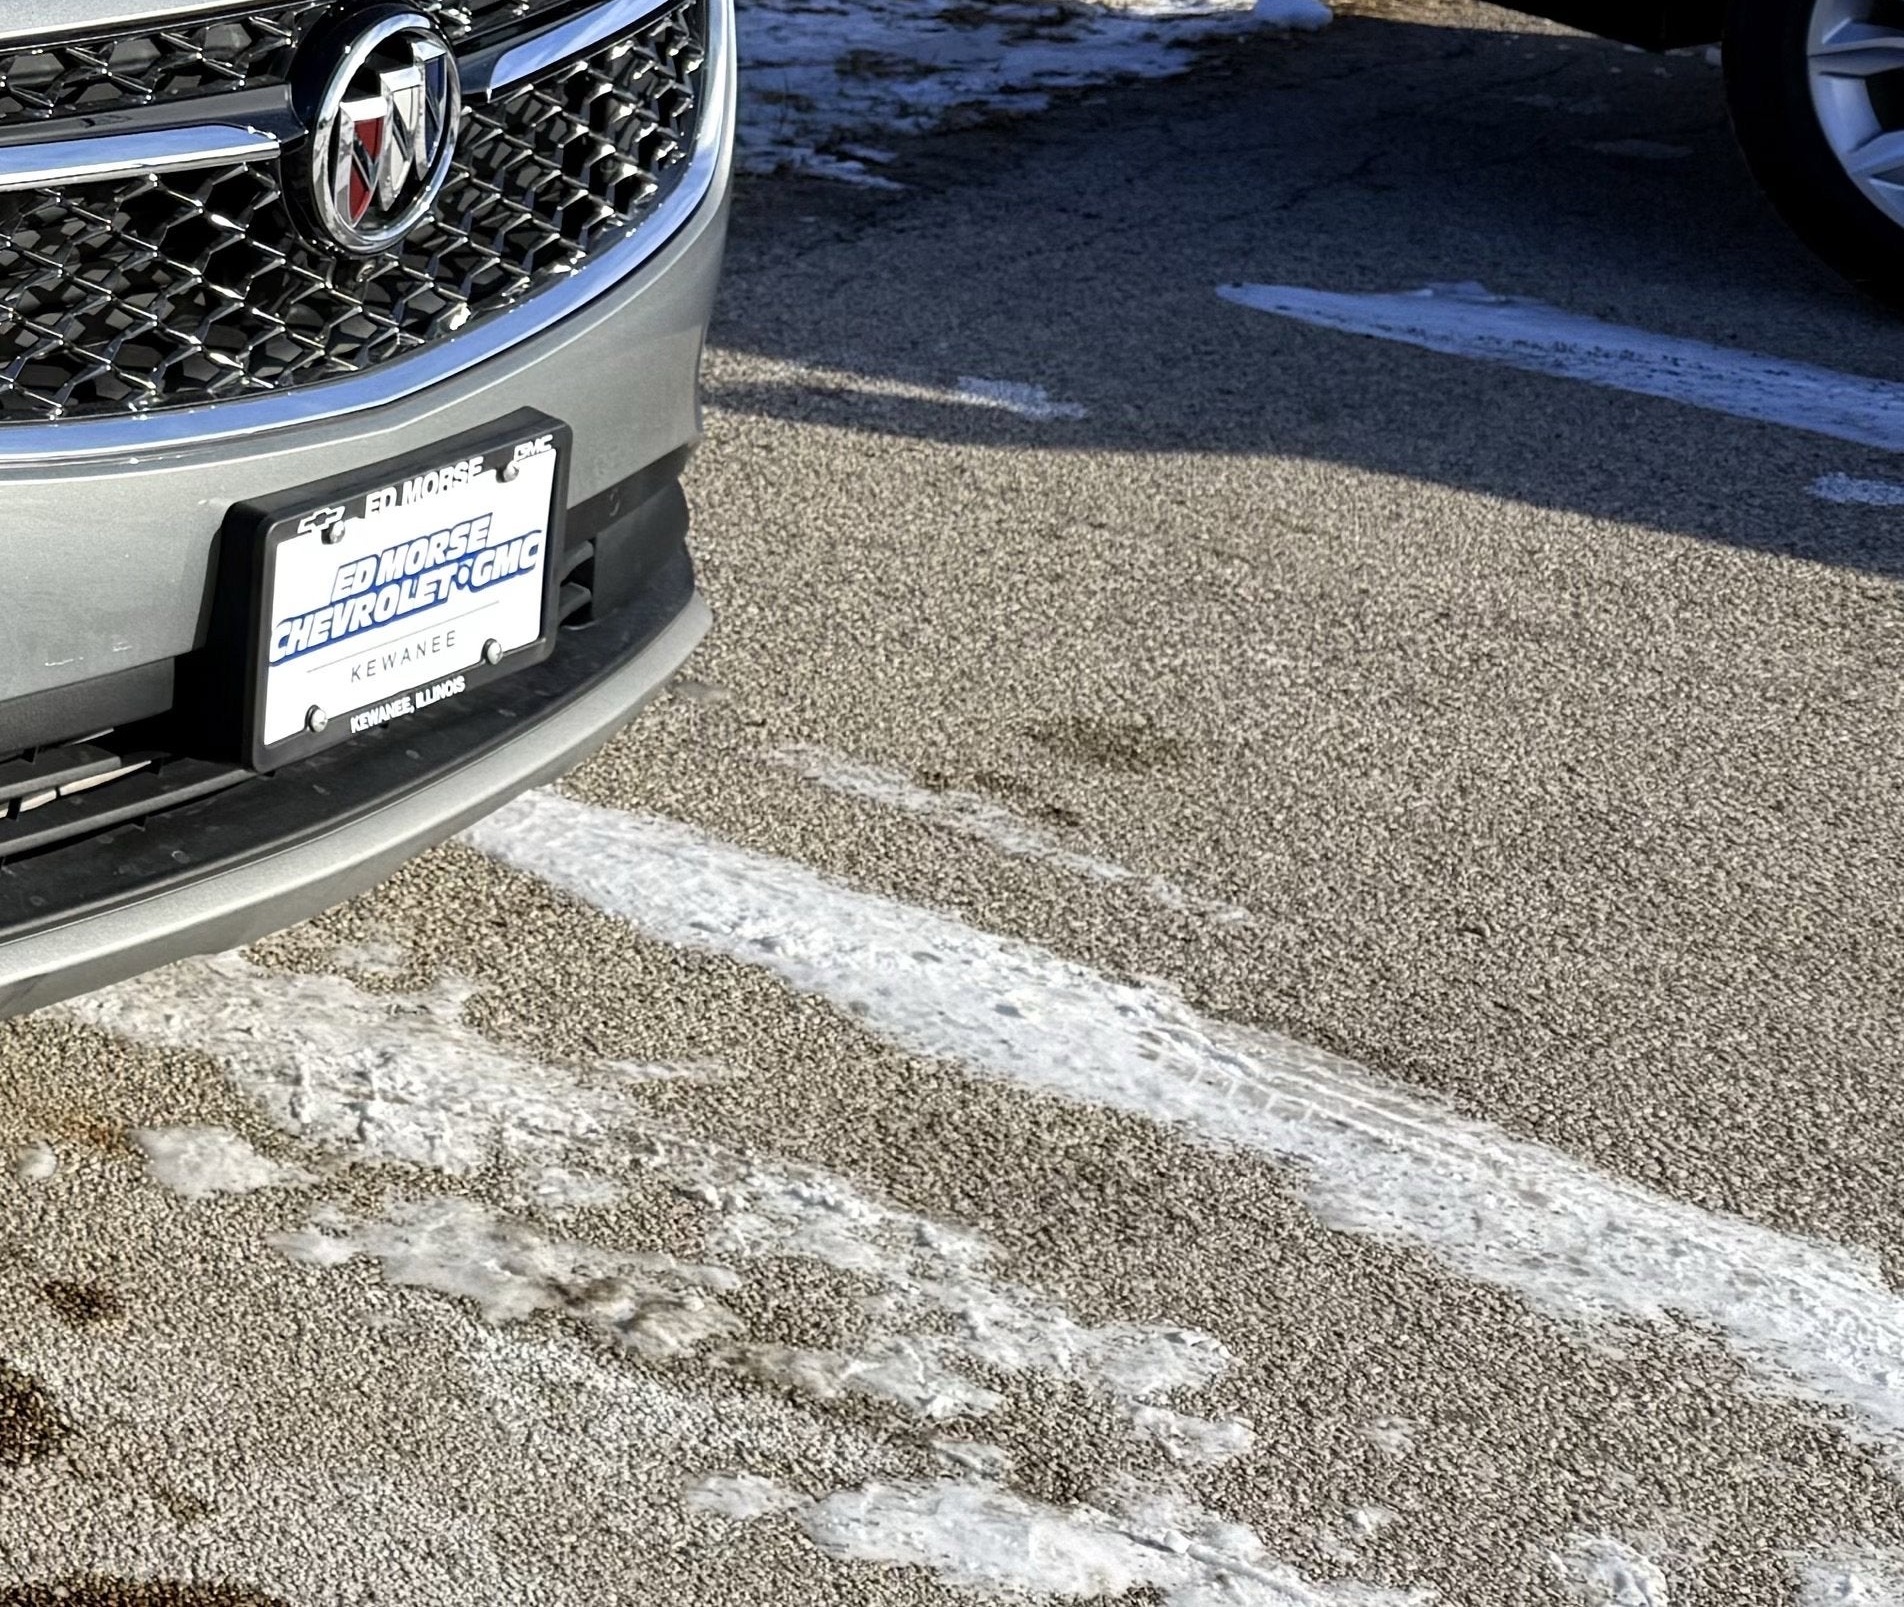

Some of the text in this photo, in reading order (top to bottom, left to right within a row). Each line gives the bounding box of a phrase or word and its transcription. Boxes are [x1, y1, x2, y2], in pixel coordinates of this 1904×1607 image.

[513, 435, 553, 461] GMC
[365, 456, 484, 515] ED MORSE
[332, 513, 492, 602] ED MORSE
[351, 630, 457, 683] KEWANEE
[350, 675, 466, 734] KEWANEE, ILLINOIS
